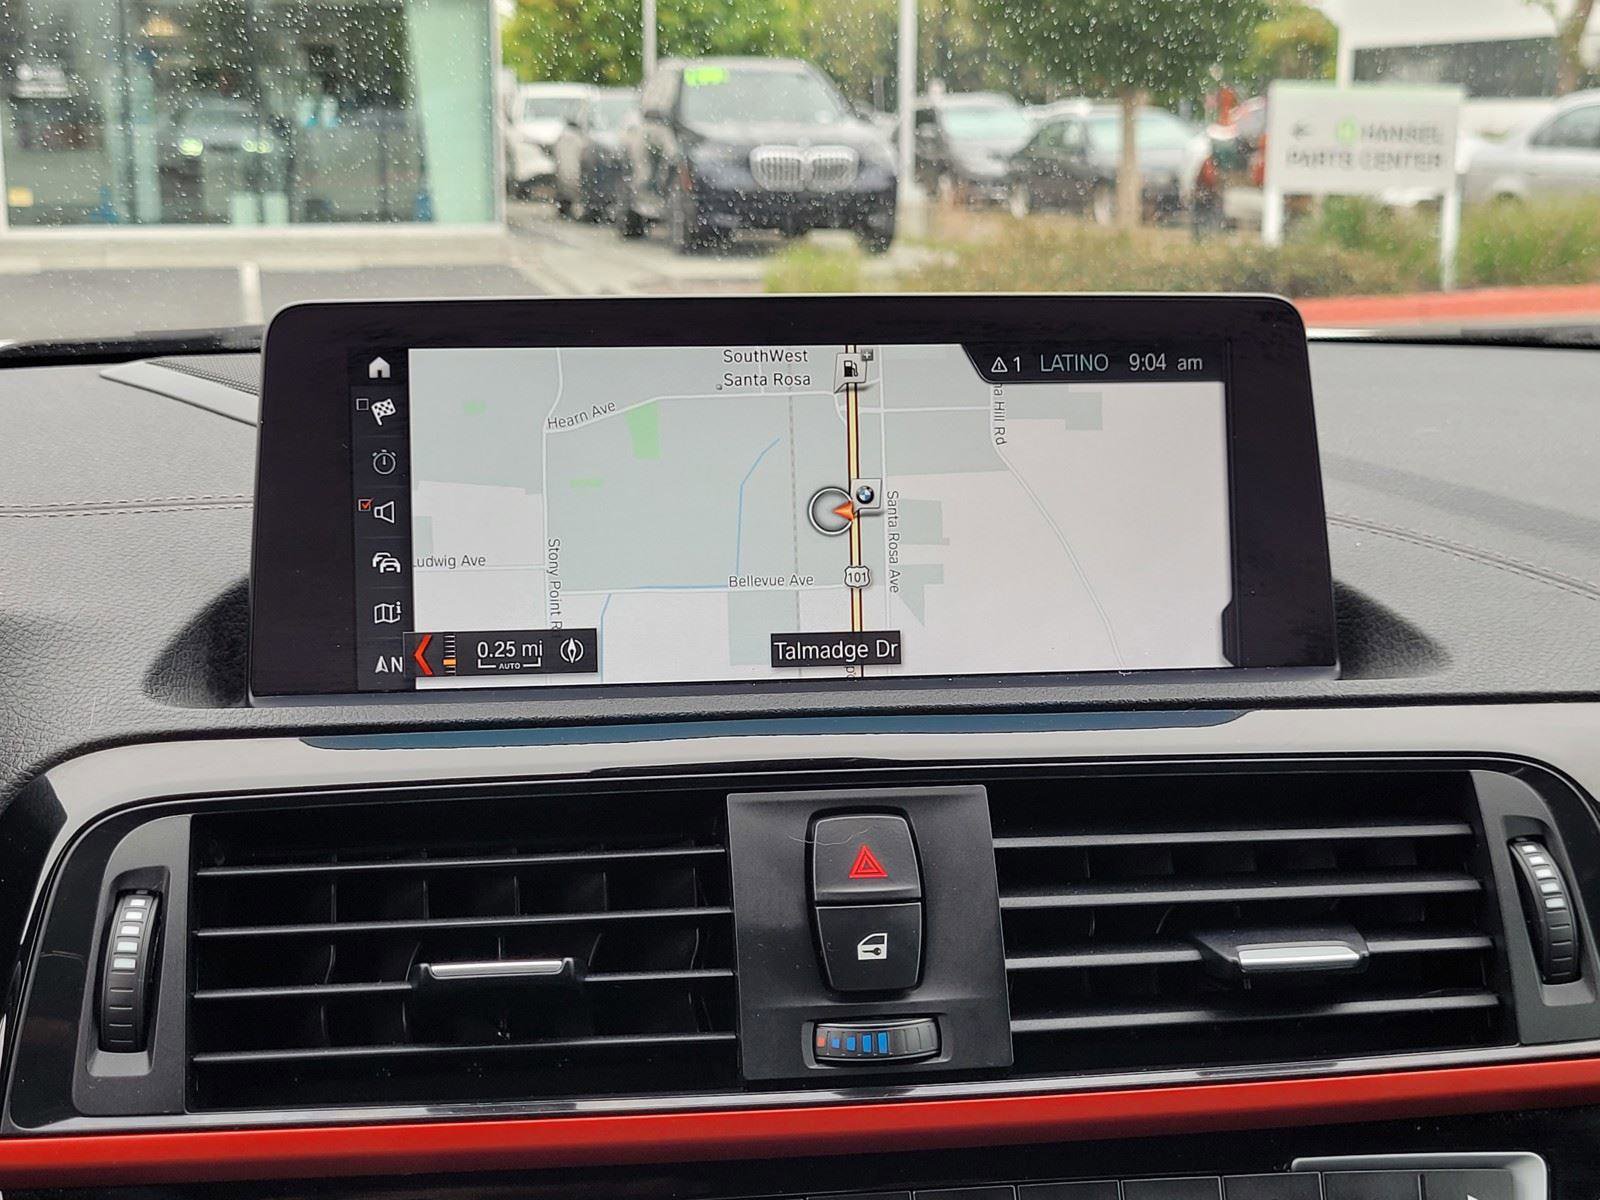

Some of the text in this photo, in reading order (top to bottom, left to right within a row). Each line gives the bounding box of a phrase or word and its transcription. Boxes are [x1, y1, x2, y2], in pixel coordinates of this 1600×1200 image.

[1286, 150, 1443, 170] PARTS CENTER
[723, 349, 809, 363] SouthWest
[1013, 353, 1203, 373] 1 LATINO 9:04 am
[724, 373, 811, 386] Santa Rosa
[548, 401, 616, 430] Hearn Ave
[994, 401, 1005, 422] Hill
[994, 427, 1007, 445] Rd
[887, 490, 901, 593] Santa Rosa Ave
[413, 554, 486, 569] udwig Ave
[546, 538, 561, 577] Stony
[729, 574, 814, 588] Bellevue Ave
[848, 571, 866, 583] 101
[550, 581, 563, 616] Point
[477, 640, 544, 658] 0.25 mi
[774, 639, 898, 662] Talmadge Dr
[498, 662, 521, 670] AUTO
